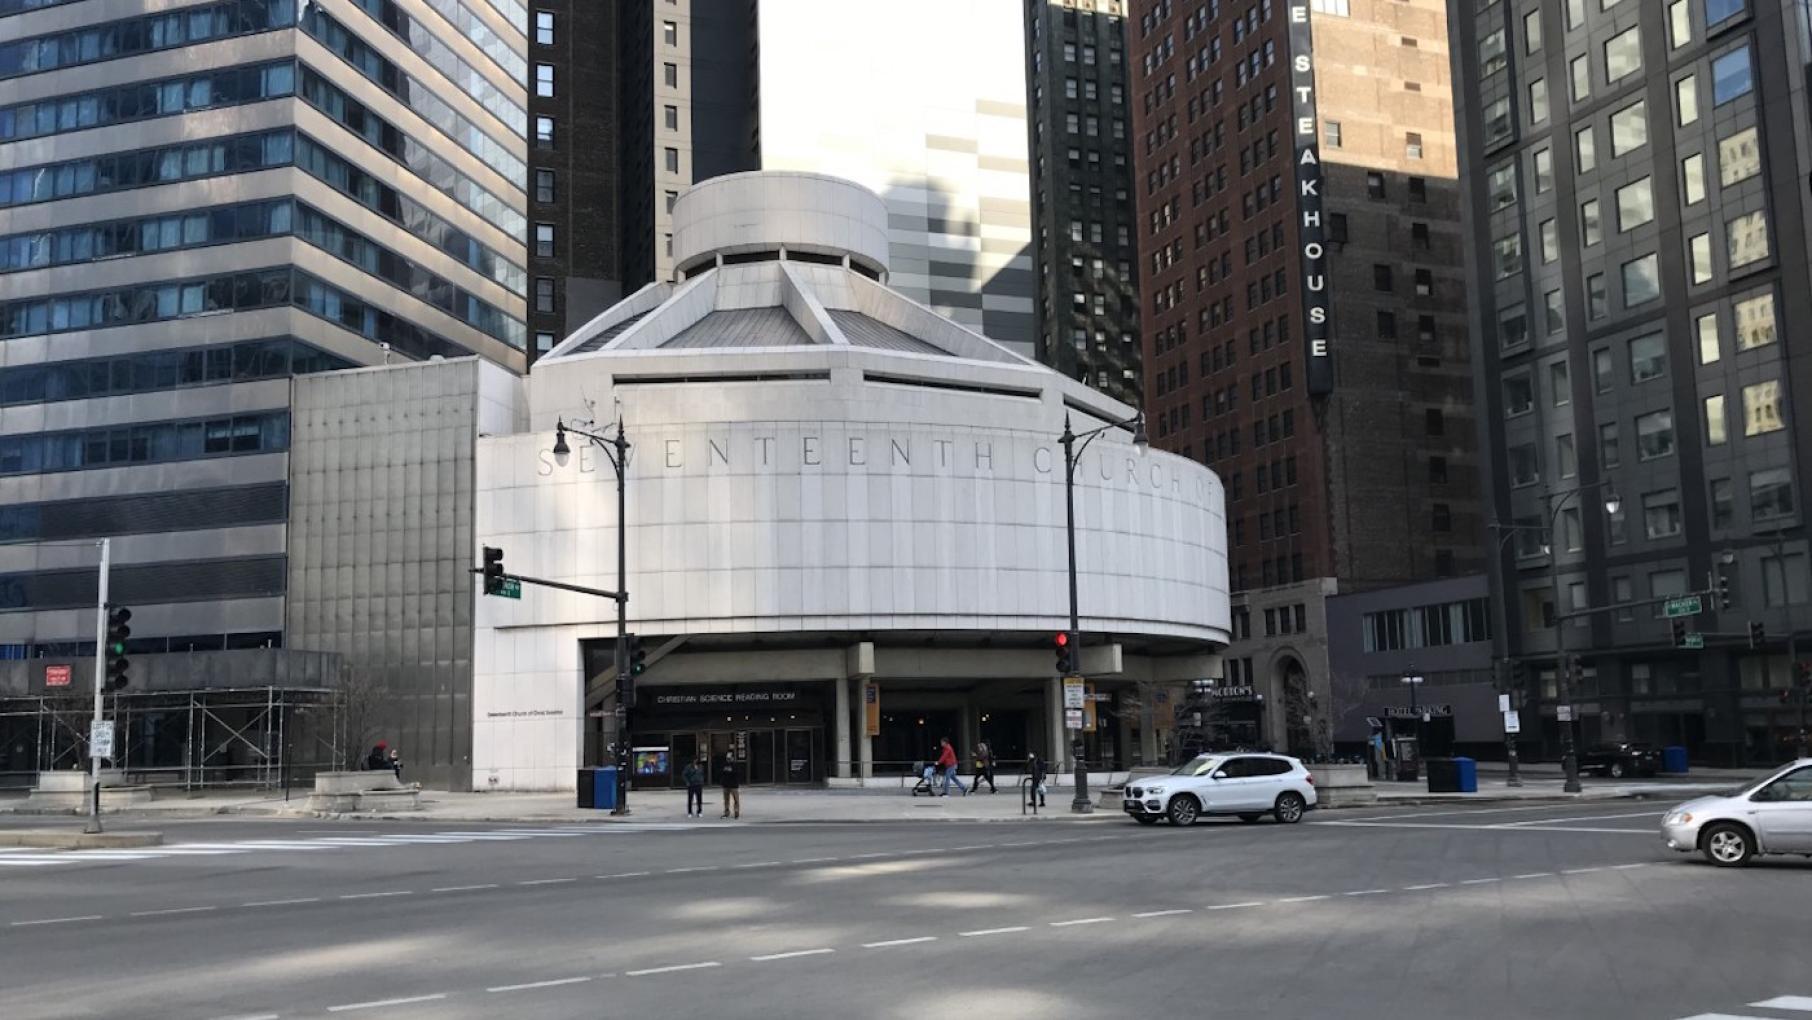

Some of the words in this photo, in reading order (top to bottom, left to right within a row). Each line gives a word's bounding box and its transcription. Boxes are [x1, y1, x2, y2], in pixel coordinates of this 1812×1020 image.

[1295, 54, 1328, 357] STEAKHOUSE
[537, 433, 993, 477] SEVENTEENTH
[1033, 447, 1181, 494] CHURCH
[657, 695, 697, 704] CHRISTIAN
[700, 694, 733, 703] SCIENCE
[735, 693, 770, 701] READING
[772, 692, 795, 701] ROOM
